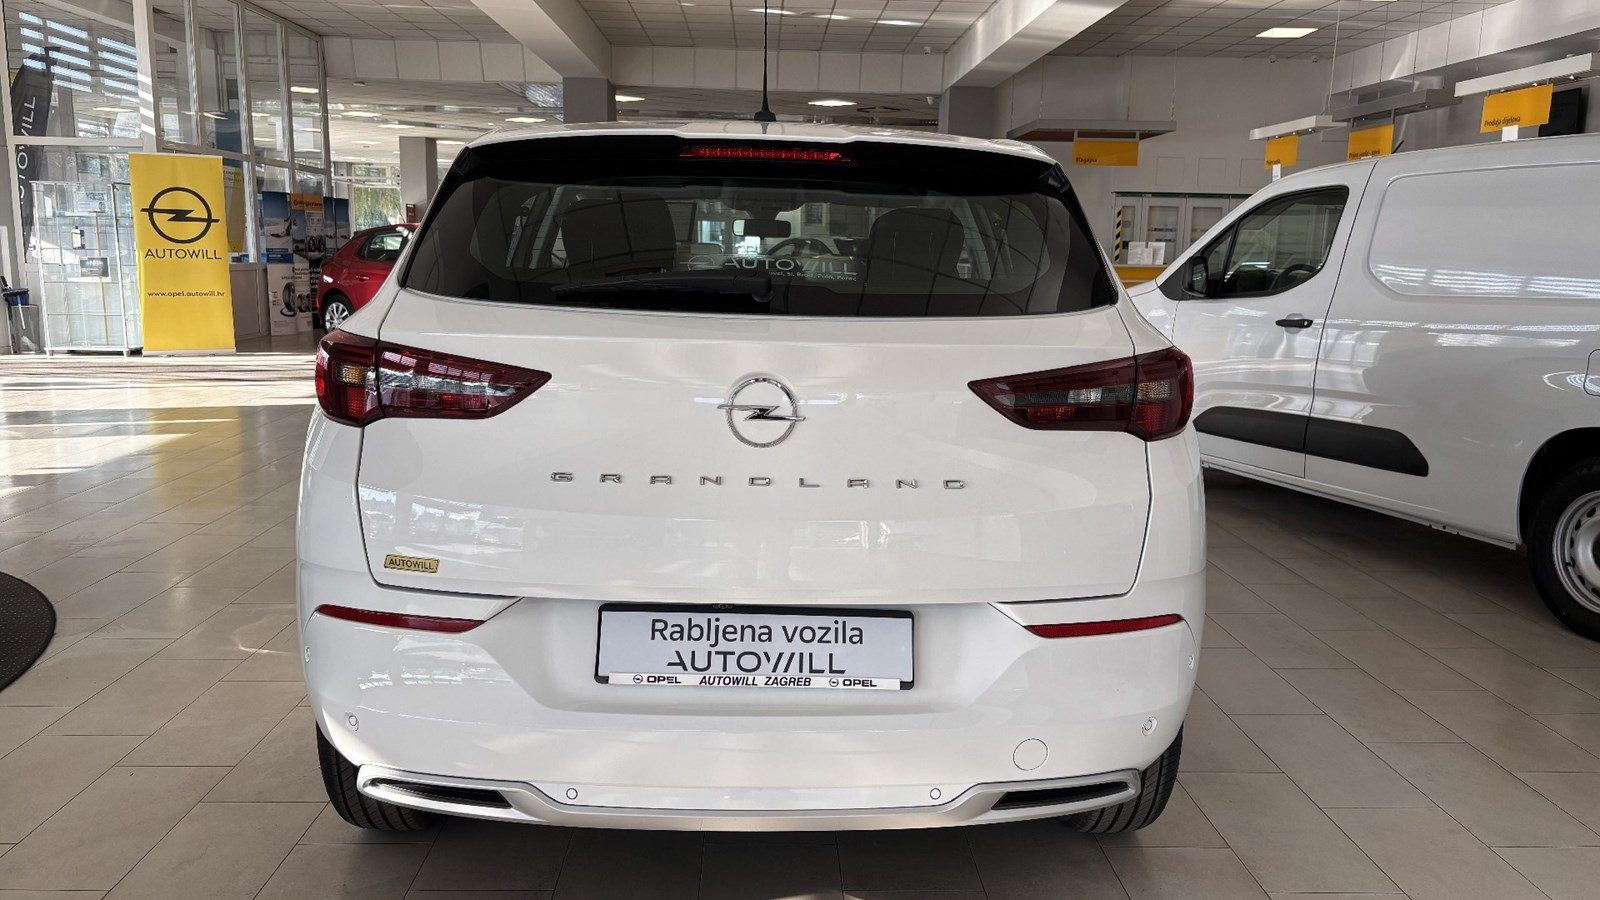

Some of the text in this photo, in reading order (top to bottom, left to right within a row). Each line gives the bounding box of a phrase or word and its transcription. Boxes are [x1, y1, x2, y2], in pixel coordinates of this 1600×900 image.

[144, 248, 222, 260] AUTOWILL
[550, 471, 968, 490] GRANDLAND
[388, 558, 434, 570] AUTOWILL
[650, 617, 864, 648] Rabljena vozila
[667, 650, 846, 675] AUTOWILL
[646, 675, 877, 688] OPEL AUTOWILL ZAGREB OPEL
